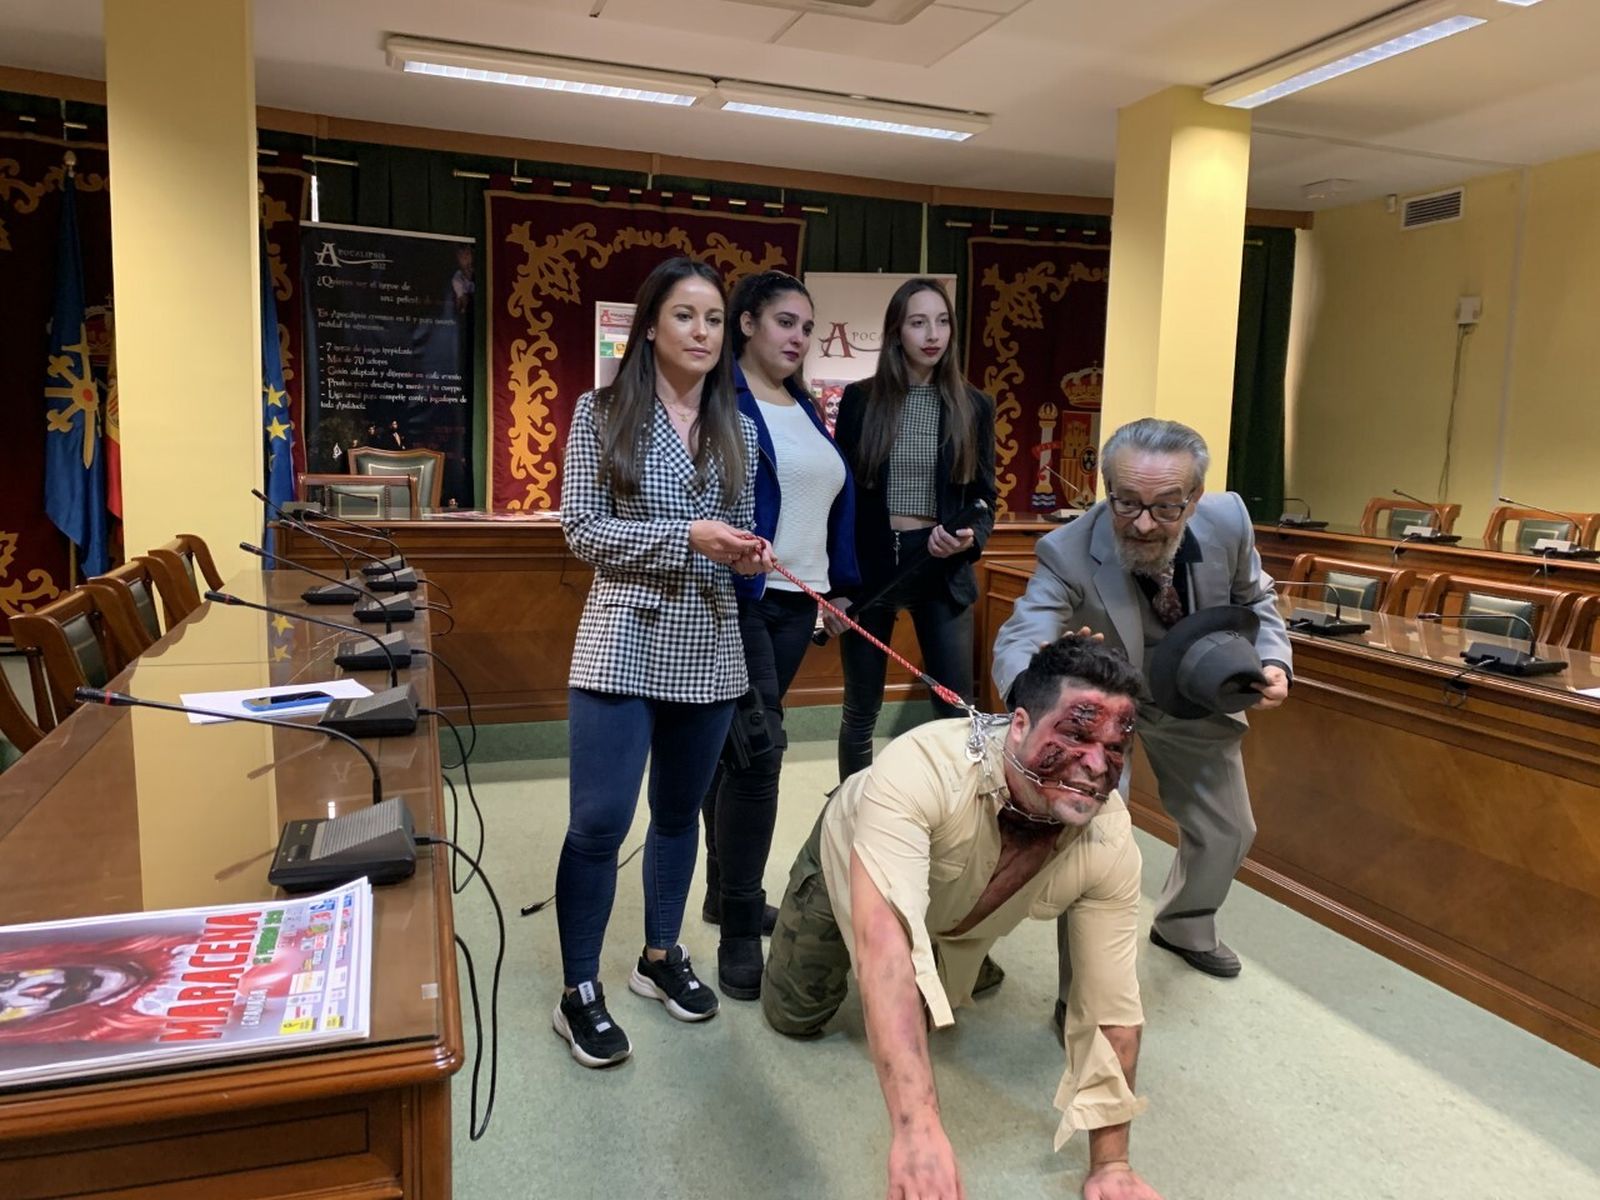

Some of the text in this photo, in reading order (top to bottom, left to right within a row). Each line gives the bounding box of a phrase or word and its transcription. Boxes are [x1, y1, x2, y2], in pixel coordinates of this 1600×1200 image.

[326, 342, 332, 351] 7
[818, 322, 882, 358] APOC
[354, 355, 365, 365] 70
[157, 911, 263, 1042] MARACENA
